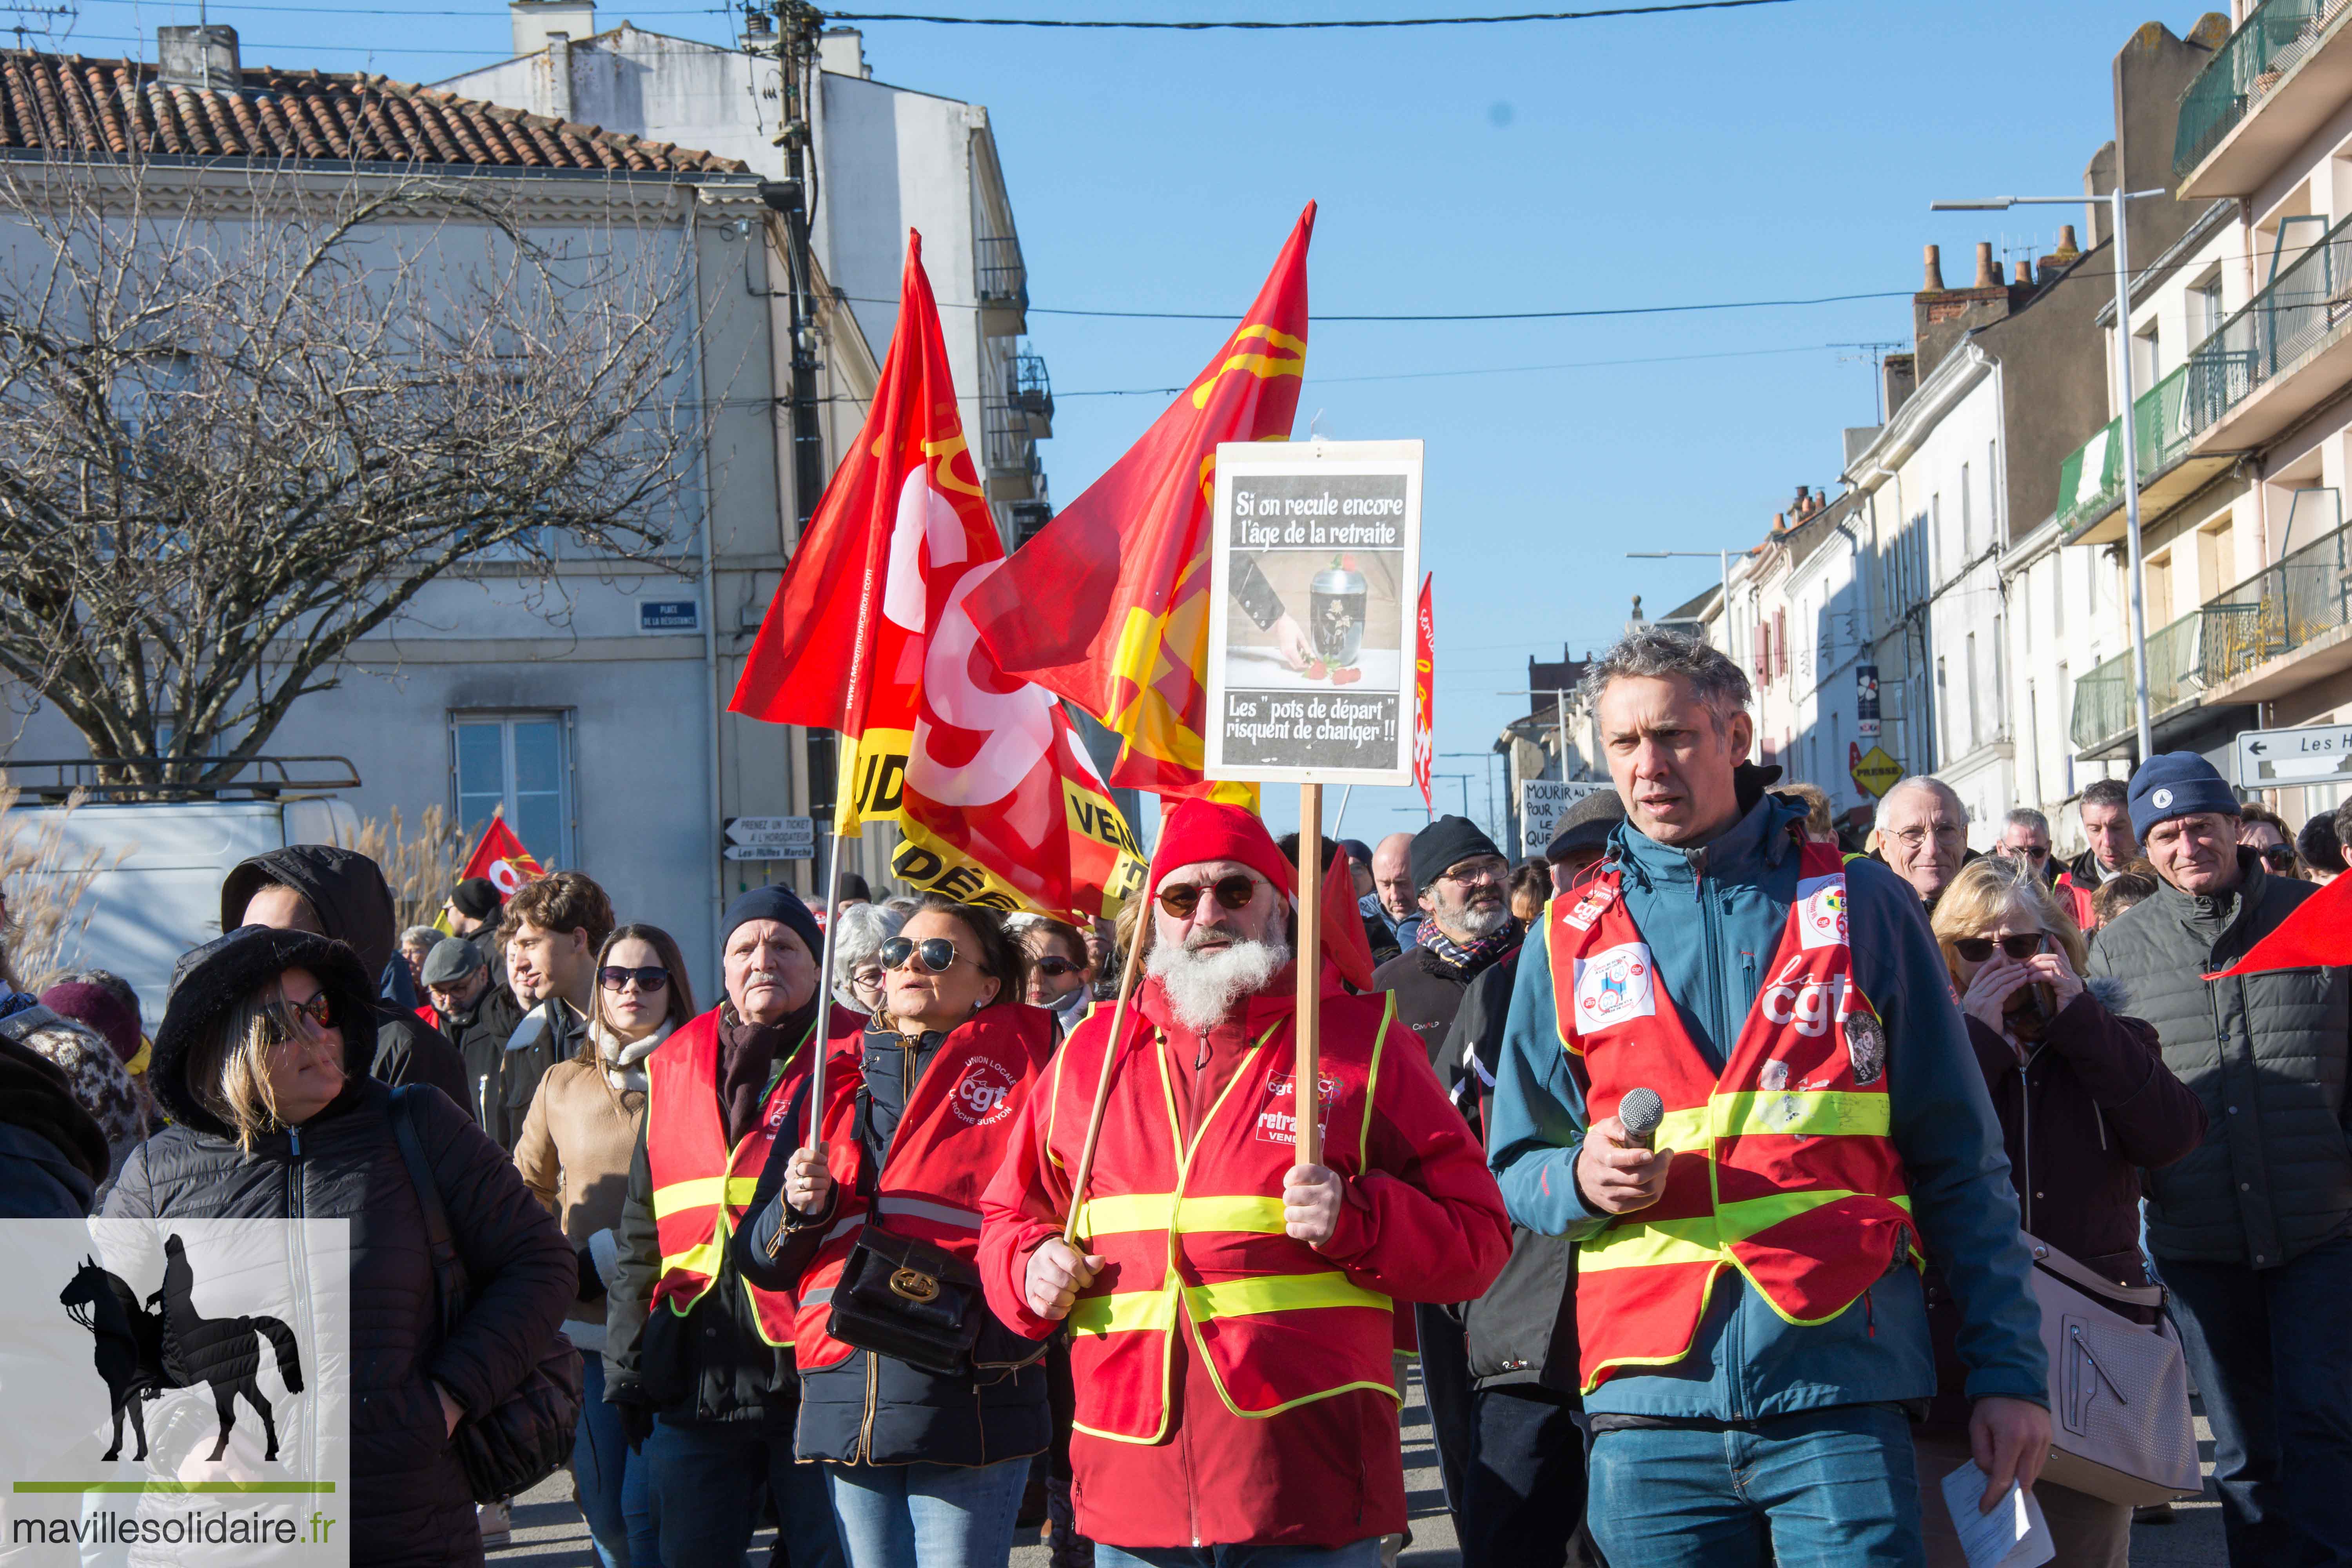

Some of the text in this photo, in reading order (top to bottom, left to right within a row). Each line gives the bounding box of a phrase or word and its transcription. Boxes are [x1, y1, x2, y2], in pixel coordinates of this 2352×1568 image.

[1236, 491, 1403, 516] Si on recule encore
[1241, 519, 1396, 552] l'âge de la retraite
[660, 605, 678, 614] PLACE
[661, 615, 695, 625] RÉSISTANCE
[846, 569, 873, 709] www.LMcommunication.com
[1229, 695, 1257, 717] Les
[1270, 699, 1304, 725] pots
[1307, 697, 1327, 719] de
[1330, 698, 1383, 726] départ
[1226, 718, 1290, 746] risquent
[1293, 718, 1312, 740] de
[1316, 718, 1380, 749] changer
[2301, 737, 2332, 752] Les
[1857, 767, 1898, 777] PRESSE
[1574, 789, 1585, 797] AU
[1526, 802, 1553, 817] POUR
[740, 819, 810, 830] PRENEZ UN TICKET
[1539, 820, 1553, 830] LE
[1574, 901, 1604, 920] cgt
[1762, 974, 1853, 1037] cgt
[1412, 1021, 1439, 1031] CIMALP
[965, 1056, 1016, 1086] UNION LOCALE
[960, 1079, 1008, 1112] cgt
[1268, 1081, 1293, 1096] cgt
[949, 1088, 1013, 1126] LA ROCHE SUR YON
